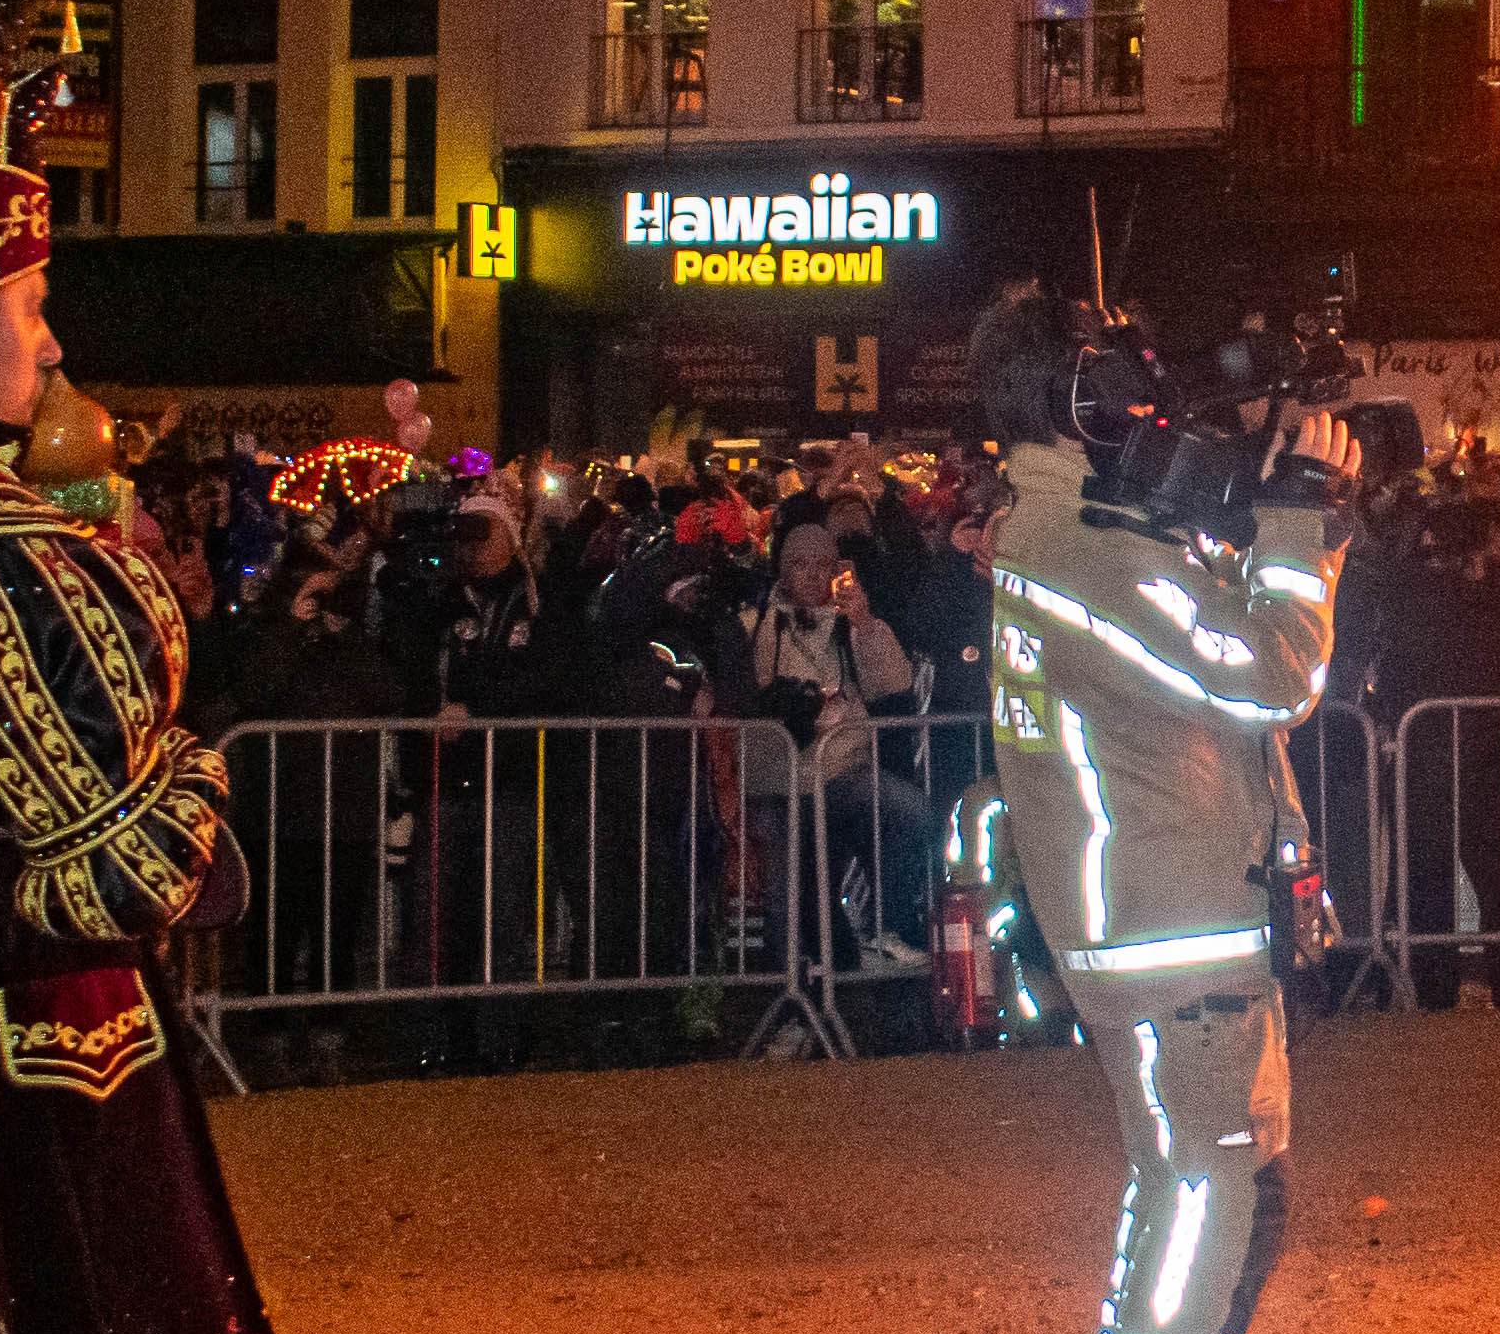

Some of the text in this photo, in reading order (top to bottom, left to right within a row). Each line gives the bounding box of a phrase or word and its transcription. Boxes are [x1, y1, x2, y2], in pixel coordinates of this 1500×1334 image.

[624, 173, 939, 244] Hawaiian
[674, 243, 884, 285] Poké Bowl
